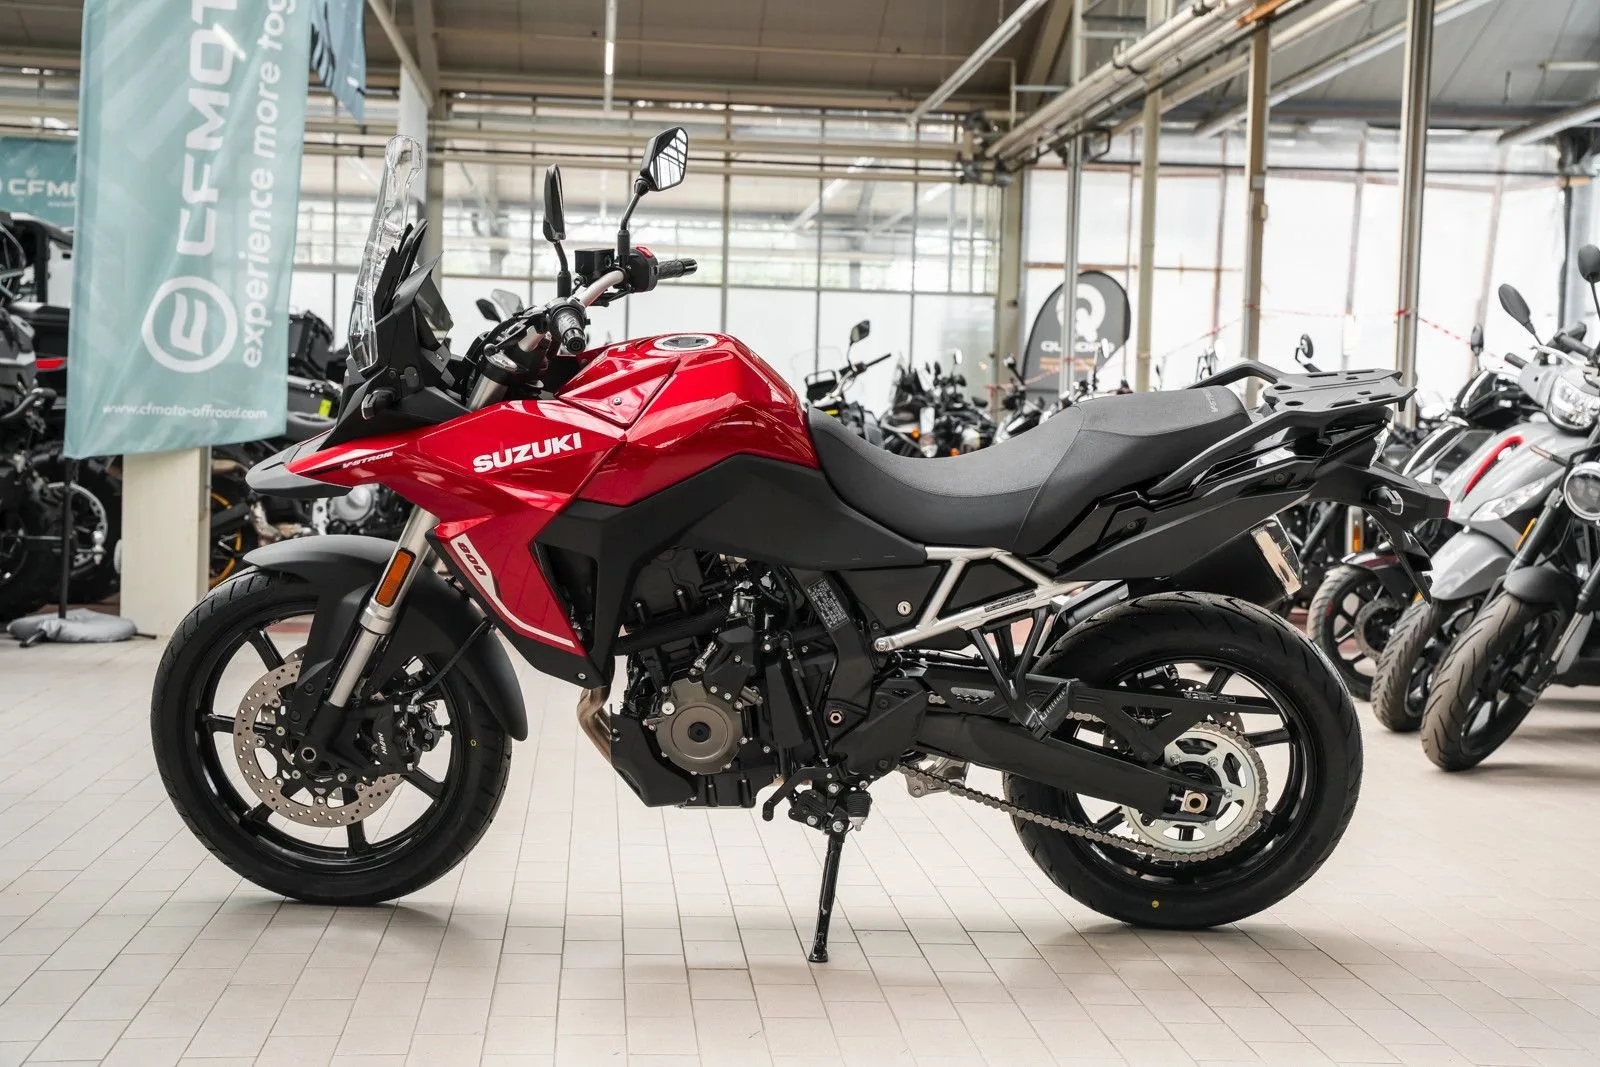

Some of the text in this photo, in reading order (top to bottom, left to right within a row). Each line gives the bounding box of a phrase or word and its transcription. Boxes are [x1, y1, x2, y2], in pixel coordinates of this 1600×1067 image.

[253, 61, 281, 158] more
[239, 167, 274, 368] experience
[472, 431, 582, 473] SUZUKI
[457, 542, 487, 576] 800
